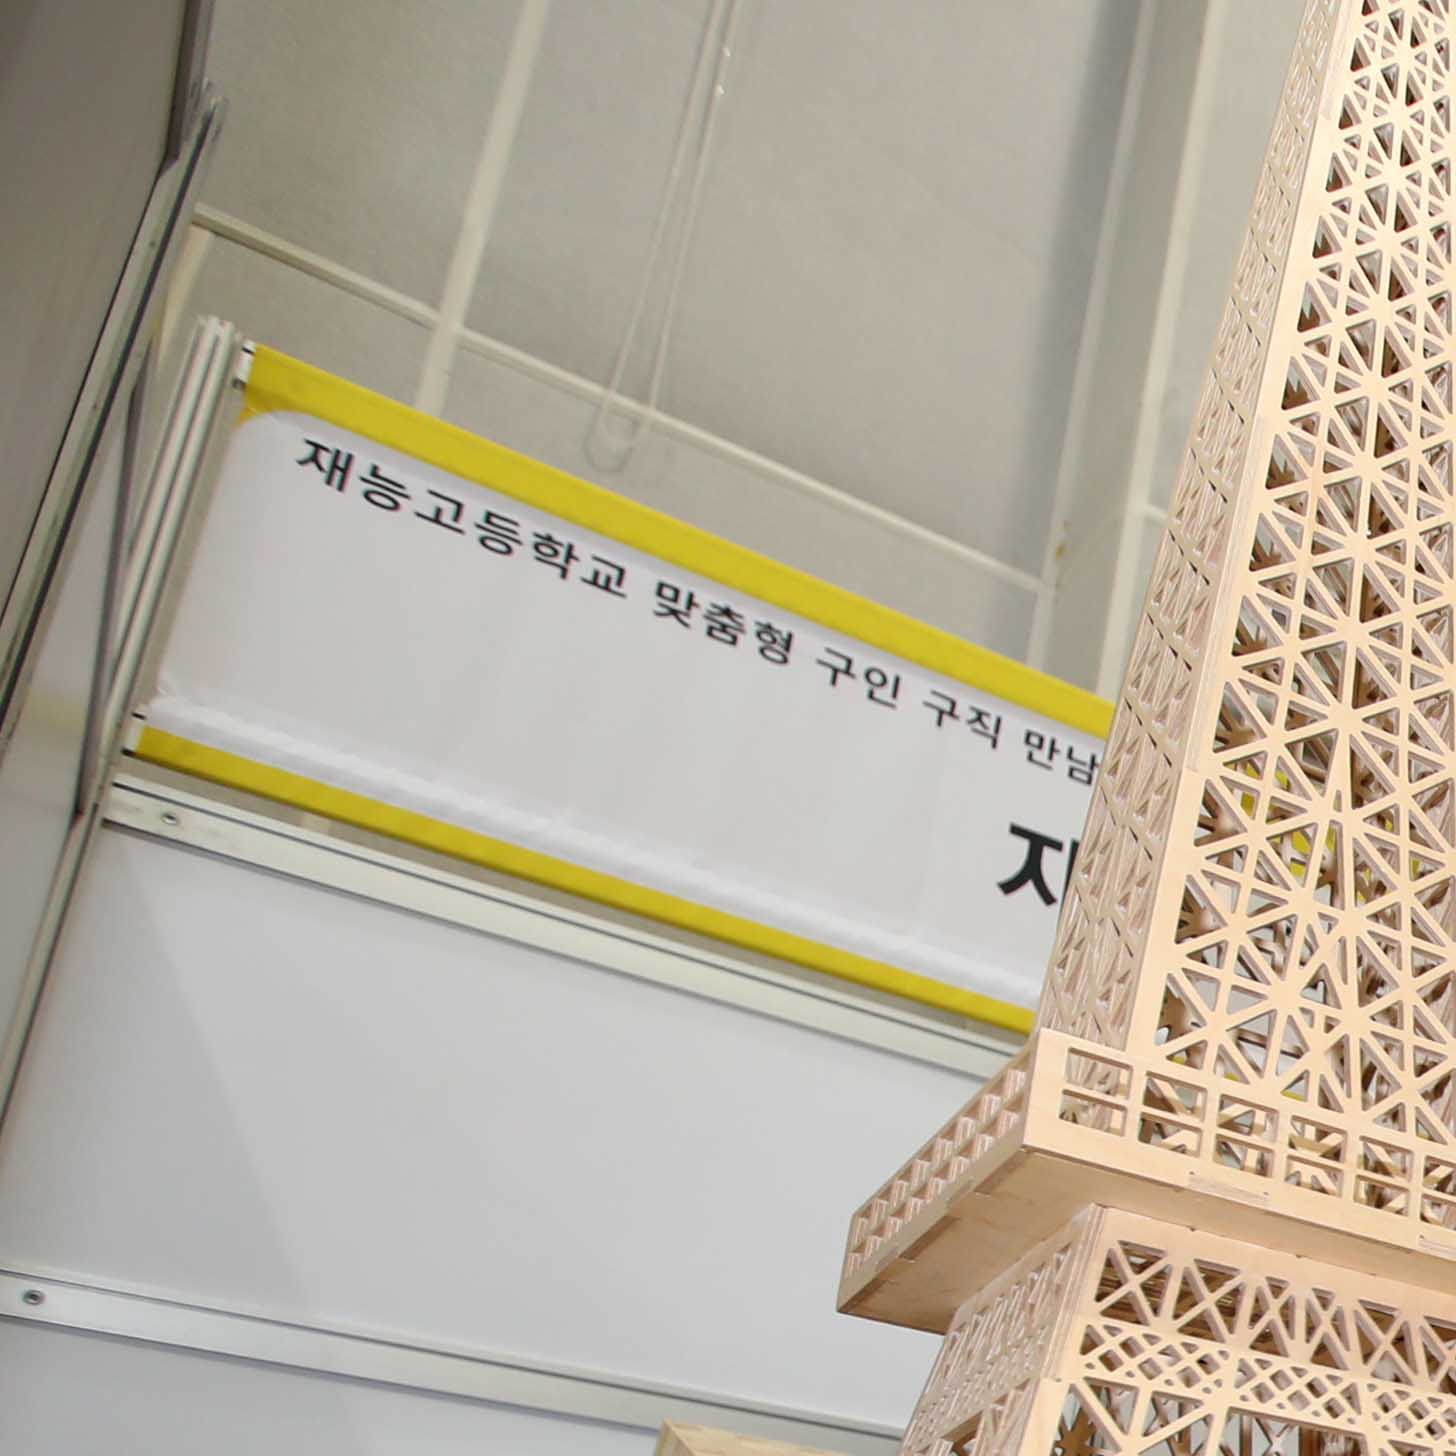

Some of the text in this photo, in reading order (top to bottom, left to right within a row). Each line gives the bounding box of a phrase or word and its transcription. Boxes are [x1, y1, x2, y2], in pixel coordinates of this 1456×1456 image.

[296, 437, 629, 599] 재능고등학교
[652, 580, 794, 665] 맞춤형
[815, 646, 901, 710] 구인
[922, 690, 1002, 750] 구직
